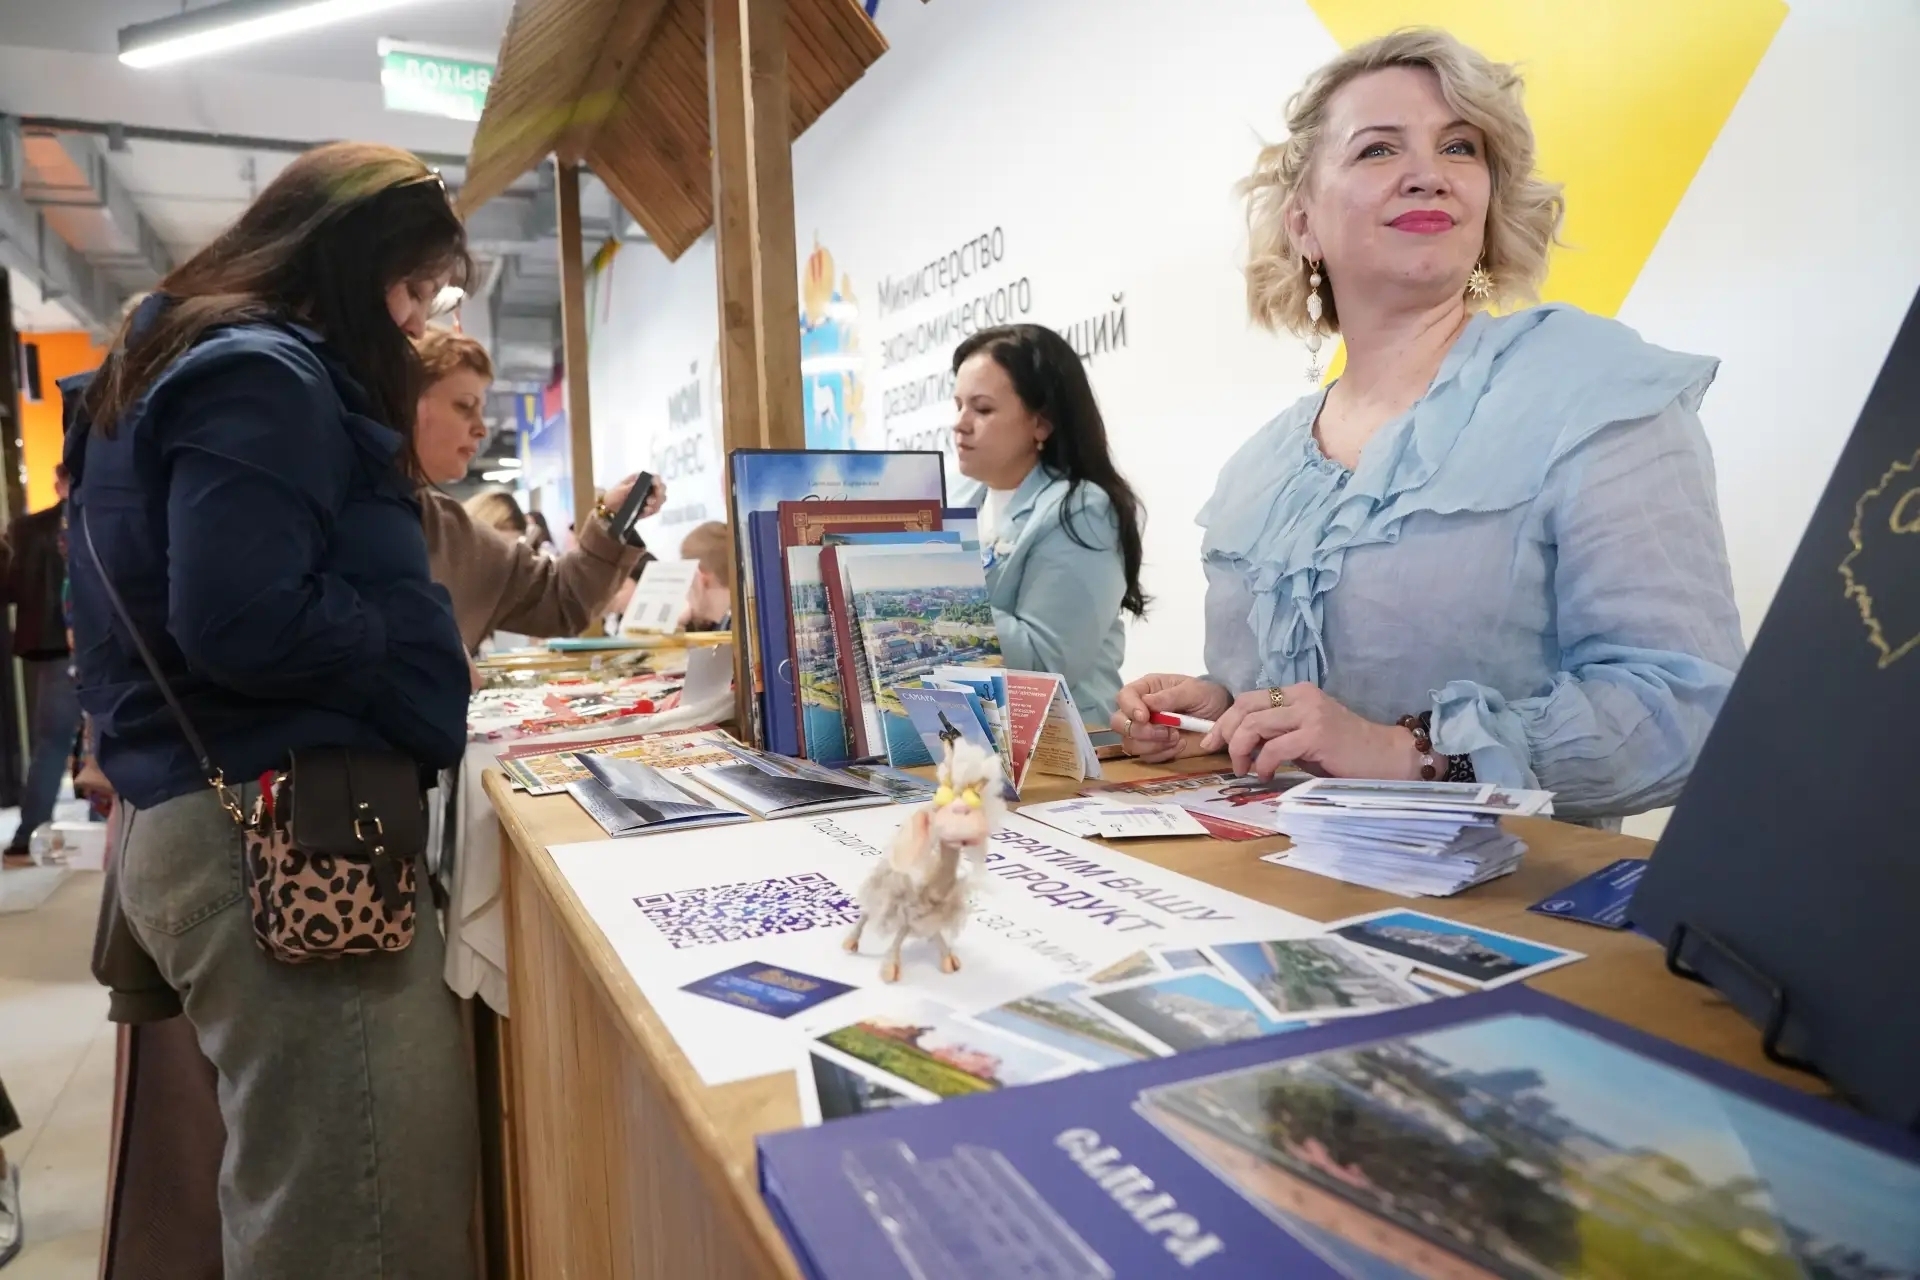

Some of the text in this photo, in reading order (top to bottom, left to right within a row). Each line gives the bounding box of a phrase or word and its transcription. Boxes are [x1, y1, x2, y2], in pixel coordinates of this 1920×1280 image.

[877, 225, 1005, 316] Министерство
[881, 276, 1031, 370] экономического
[987, 863, 1166, 933] ПРОДУКТ
[989, 827, 1236, 921] ВРАТИМ ВАШУ
[1024, 939, 1094, 974] мину
